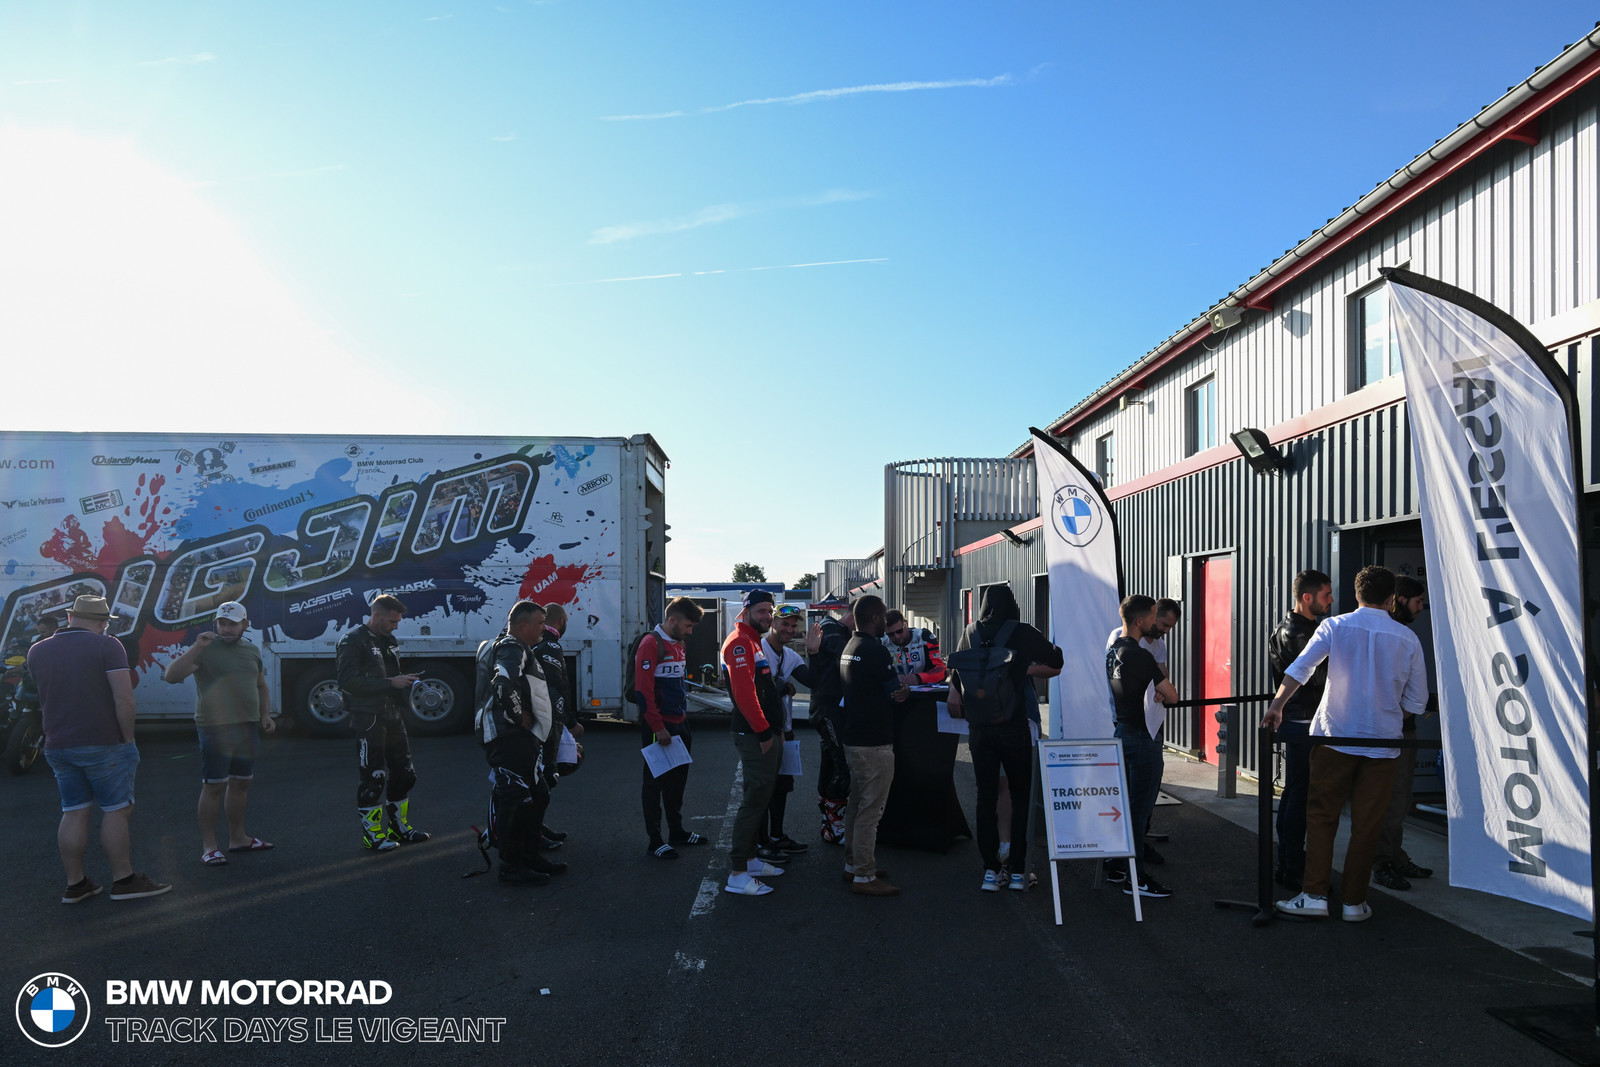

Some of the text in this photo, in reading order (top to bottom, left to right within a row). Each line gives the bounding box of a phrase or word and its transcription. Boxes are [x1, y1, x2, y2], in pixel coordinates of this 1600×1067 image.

[376, 458, 407, 467] Motorrad
[407, 457, 424, 465] Club
[580, 475, 609, 493] ARROW
[244, 493, 306, 522] Continental
[533, 571, 559, 593] UAM
[289, 587, 353, 613] BAGSTER
[1052, 786, 1120, 797] TRACKDAYS
[1053, 801, 1082, 811] BMW
